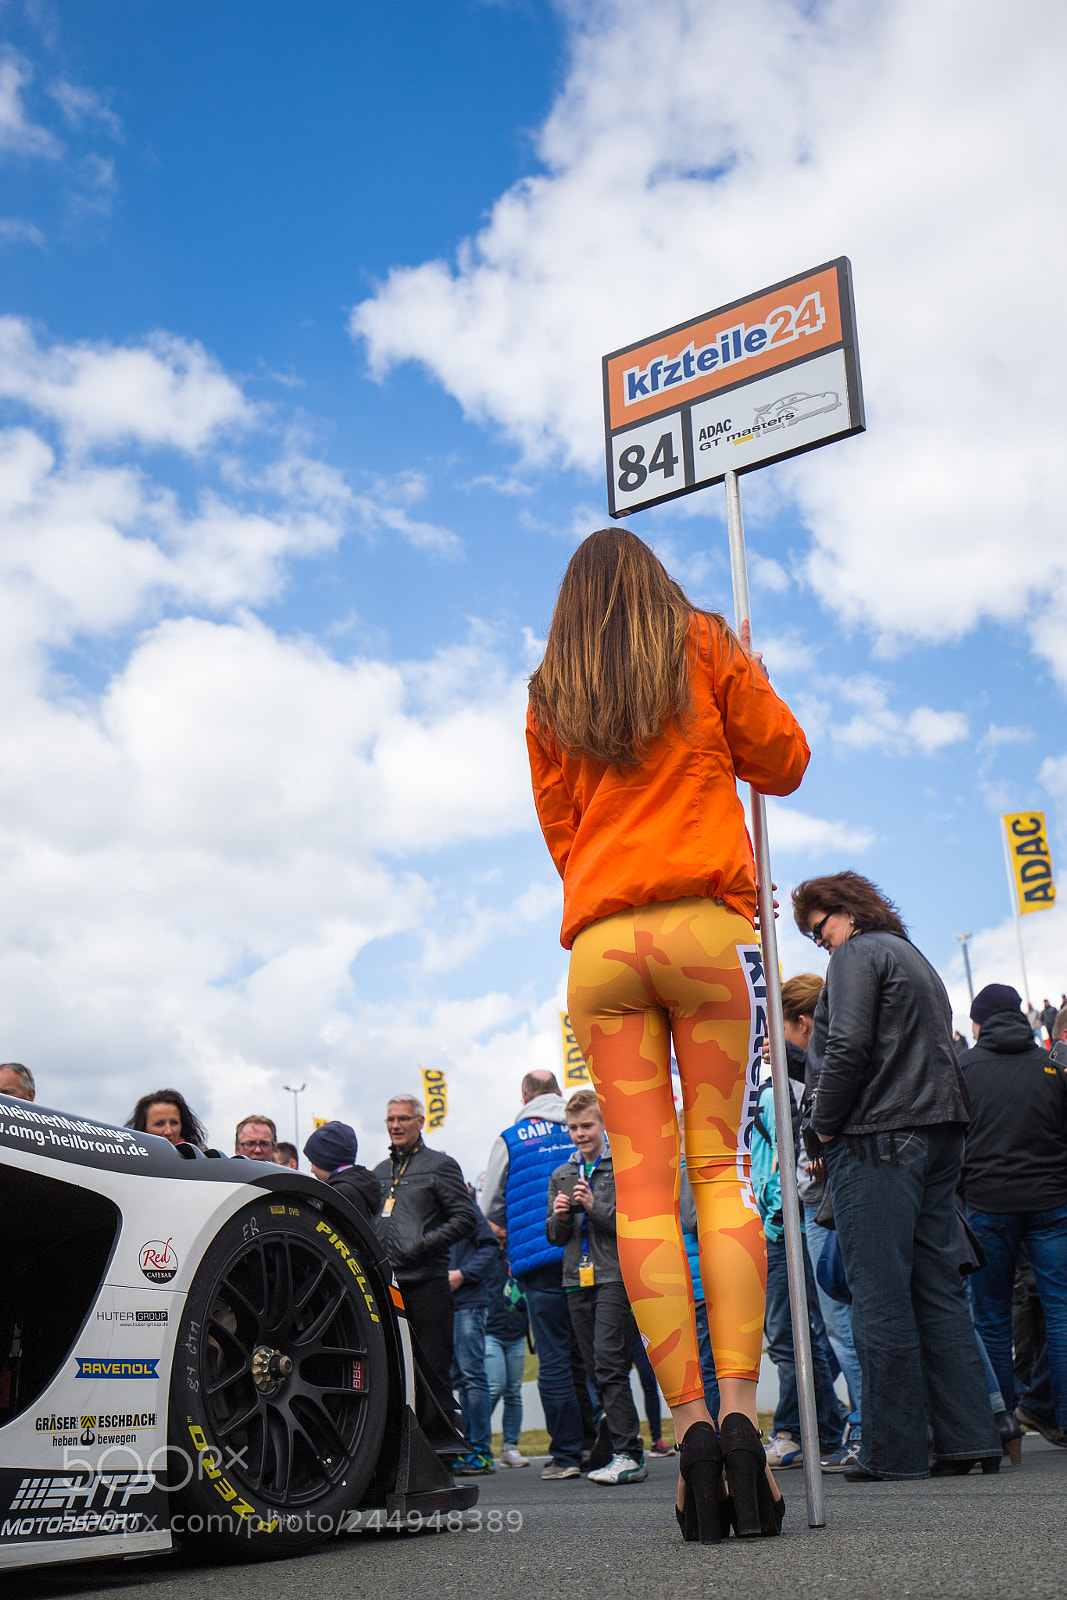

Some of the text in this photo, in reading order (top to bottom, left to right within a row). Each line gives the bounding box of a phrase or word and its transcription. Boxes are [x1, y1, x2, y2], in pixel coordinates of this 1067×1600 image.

[626, 294, 823, 403] kfzteile24
[699, 419, 732, 441] ADAC
[699, 412, 795, 451] GT masters
[618, 432, 678, 492] 84
[1012, 816, 1055, 903] ADAC
[425, 1070, 445, 1129] ADAC
[0, 1103, 136, 1142] heimerMulfinger
[517, 1121, 554, 1140] CAMP
[143, 1237, 172, 1269] Red
[316, 1221, 379, 1323] PIRELLI
[97, 1311, 167, 1321] HUTER GROUP
[82, 1363, 153, 1375] RAVENOL
[352, 1360, 362, 1390] BBS
[35, 1414, 77, 1430] GRÄSER
[98, 1413, 156, 1428] ESCHBACH
[52, 1434, 137, 1447] heben bewegen
[1, 1513, 143, 1536] MOTORSPORT
